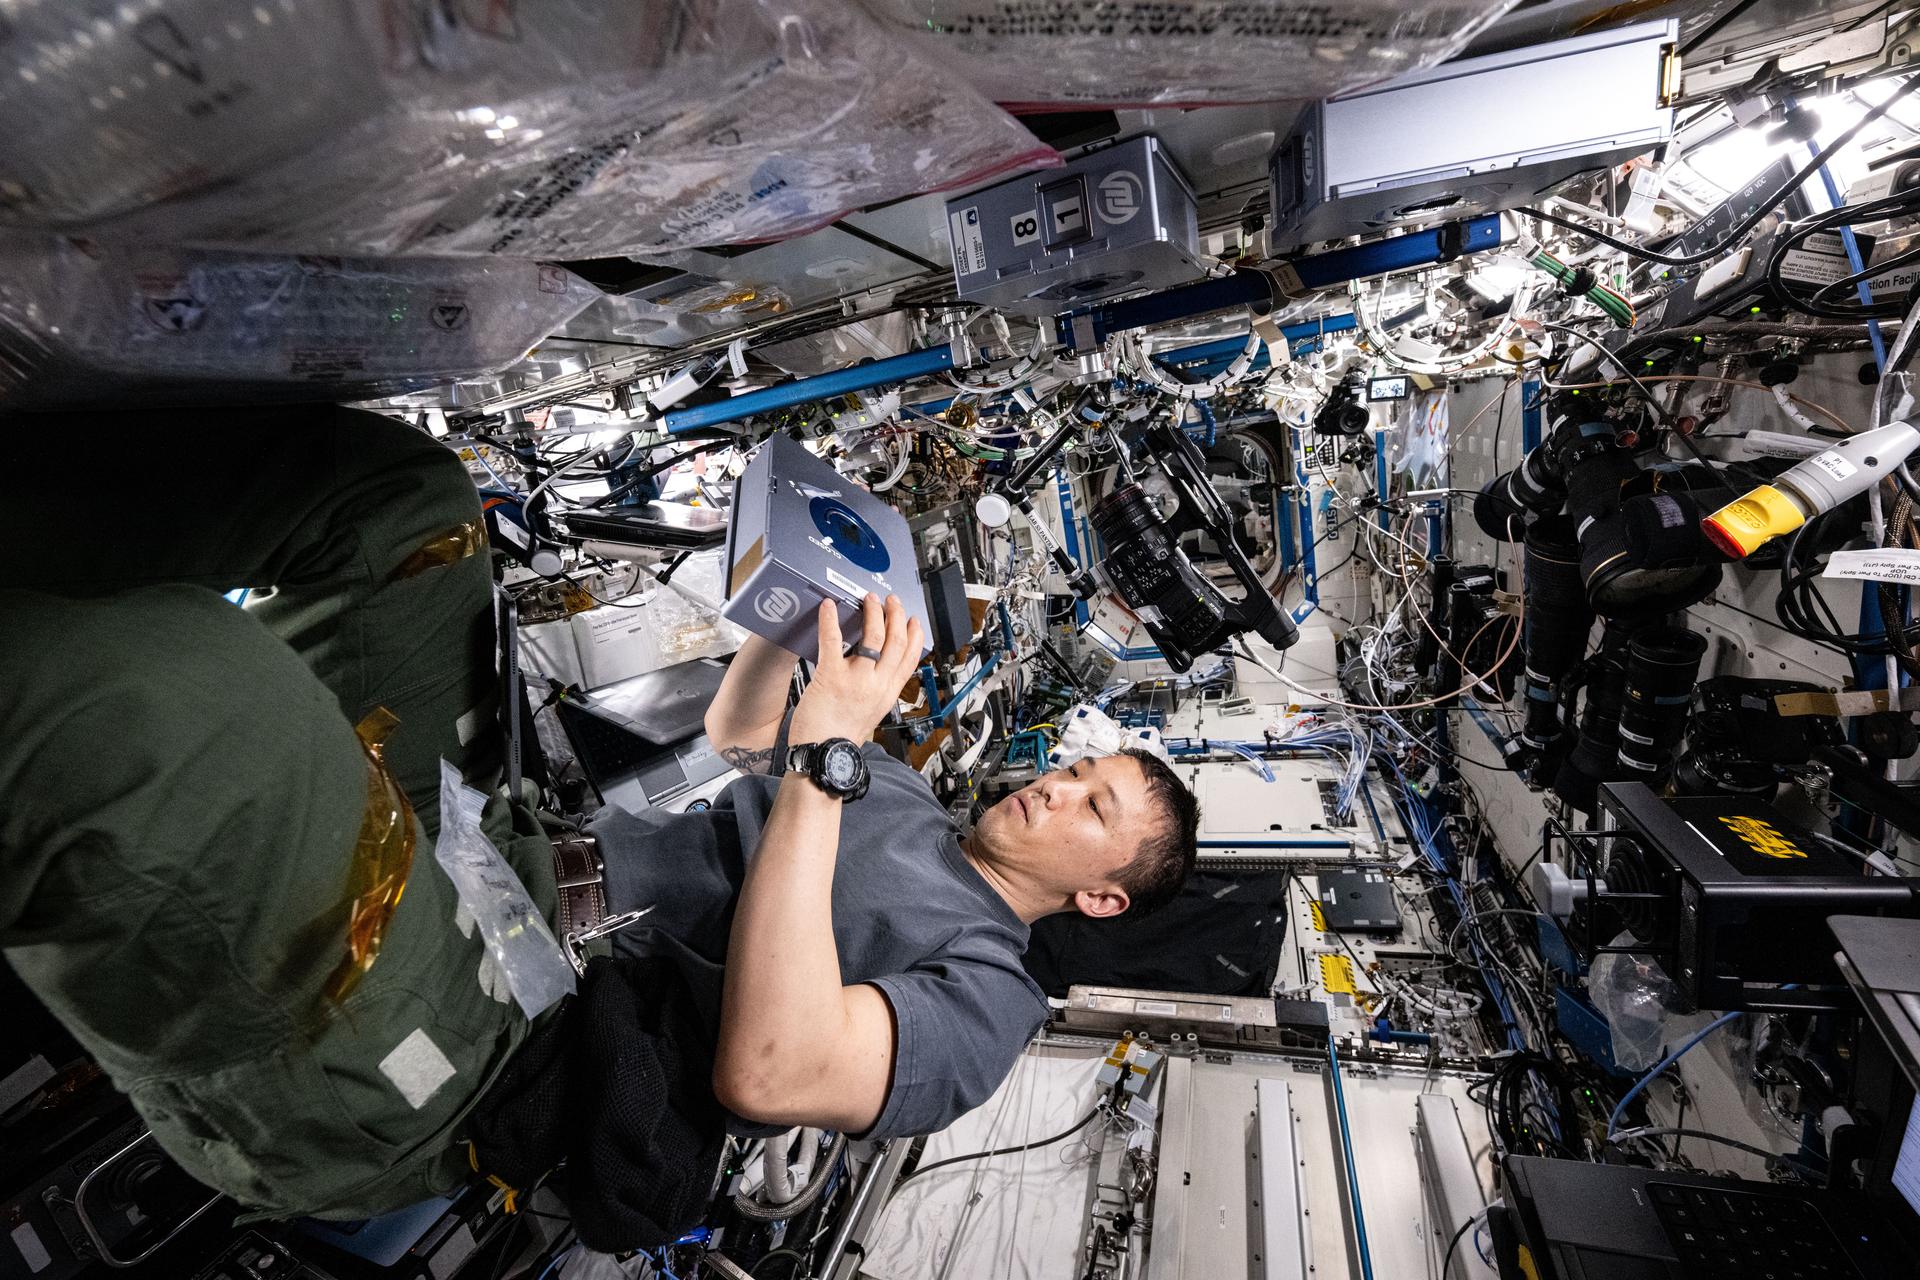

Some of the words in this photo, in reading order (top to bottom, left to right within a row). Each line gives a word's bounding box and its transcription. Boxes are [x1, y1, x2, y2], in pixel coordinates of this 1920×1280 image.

[1743, 186, 1754, 197] 120
[1753, 176, 1767, 189] VDC
[1014, 217, 1037, 238] 8
[1056, 208, 1080, 226] 1
[1695, 224, 1705, 234] 120
[1704, 215, 1717, 227] VDC
[1833, 456, 1842, 465] P1
[1028, 514, 1037, 525] LAB
[1038, 529, 1054, 551] PANTRY
[808, 535, 842, 560] CLOSED
[1882, 571, 1901, 579] (UOP
